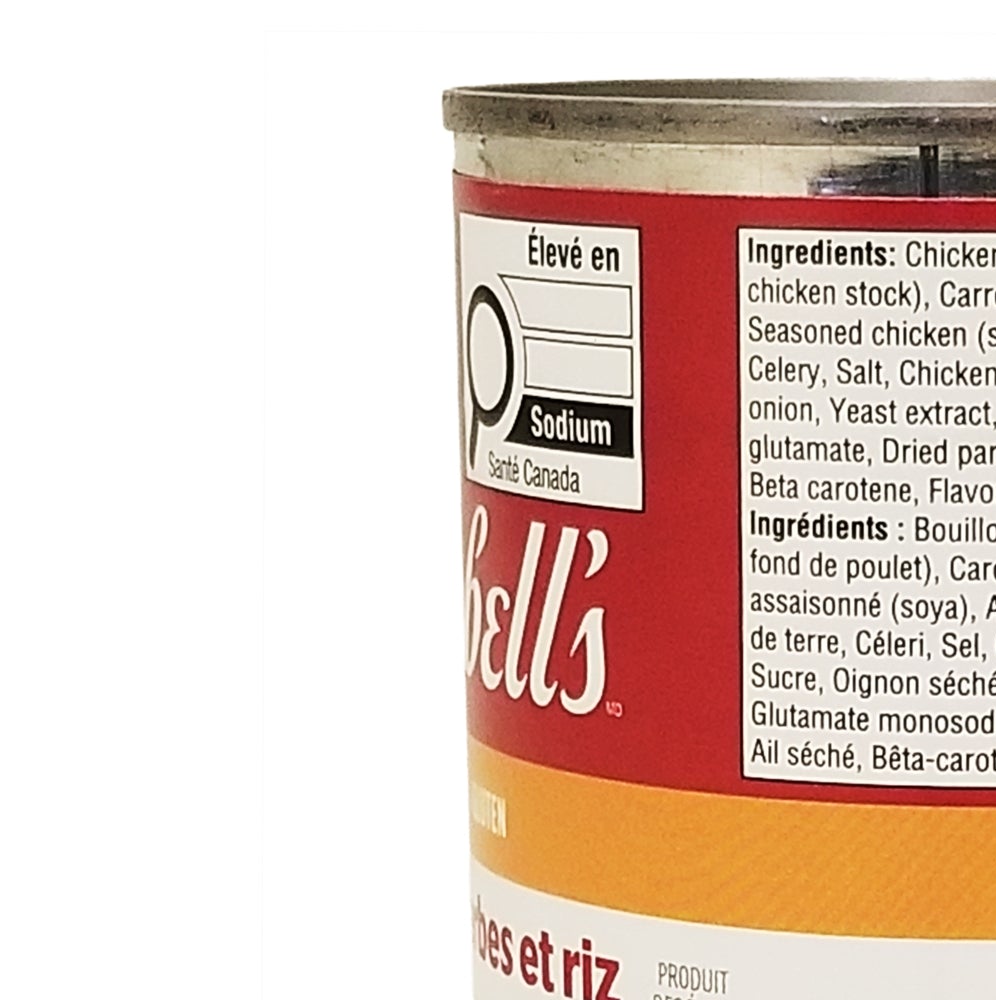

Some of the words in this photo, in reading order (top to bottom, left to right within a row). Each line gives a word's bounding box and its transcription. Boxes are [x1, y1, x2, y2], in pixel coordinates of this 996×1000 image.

[528, 226, 582, 270] Élevé
[591, 246, 620, 272] en
[748, 237, 896, 270] Ingredients:
[748, 277, 836, 305] chicken
[845, 280, 930, 313] stock),
[748, 315, 862, 345] Seasoned
[871, 320, 967, 347] chicken
[748, 354, 827, 389] Celery,
[836, 357, 889, 389] Salt,
[531, 406, 612, 446] Sodium
[749, 395, 820, 426] onion,
[829, 397, 897, 425] Yeast
[749, 433, 872, 467] glutamate,
[883, 437, 948, 465] Dried
[488, 450, 520, 484] Santé
[523, 458, 581, 494] Canada
[750, 471, 799, 499] Beta
[807, 477, 919, 506] carotene,
[750, 510, 889, 543] Ingrédients
[750, 548, 800, 576] fond
[809, 551, 837, 578] de
[846, 554, 939, 587] poulet),
[750, 589, 881, 618] assaisonné
[891, 593, 976, 626] (soya),
[750, 625, 777, 651] de
[784, 628, 846, 658] terre,
[856, 629, 931, 661] Céleri,
[942, 632, 987, 662] Sel,
[751, 662, 823, 695] Sucre,
[833, 667, 919, 699] Oignon
[751, 700, 870, 732] Glutamate
[751, 738, 778, 764] Ail
[787, 741, 862, 772] séché,
[520, 930, 554, 992] et
[658, 962, 728, 994] PRODUIT
